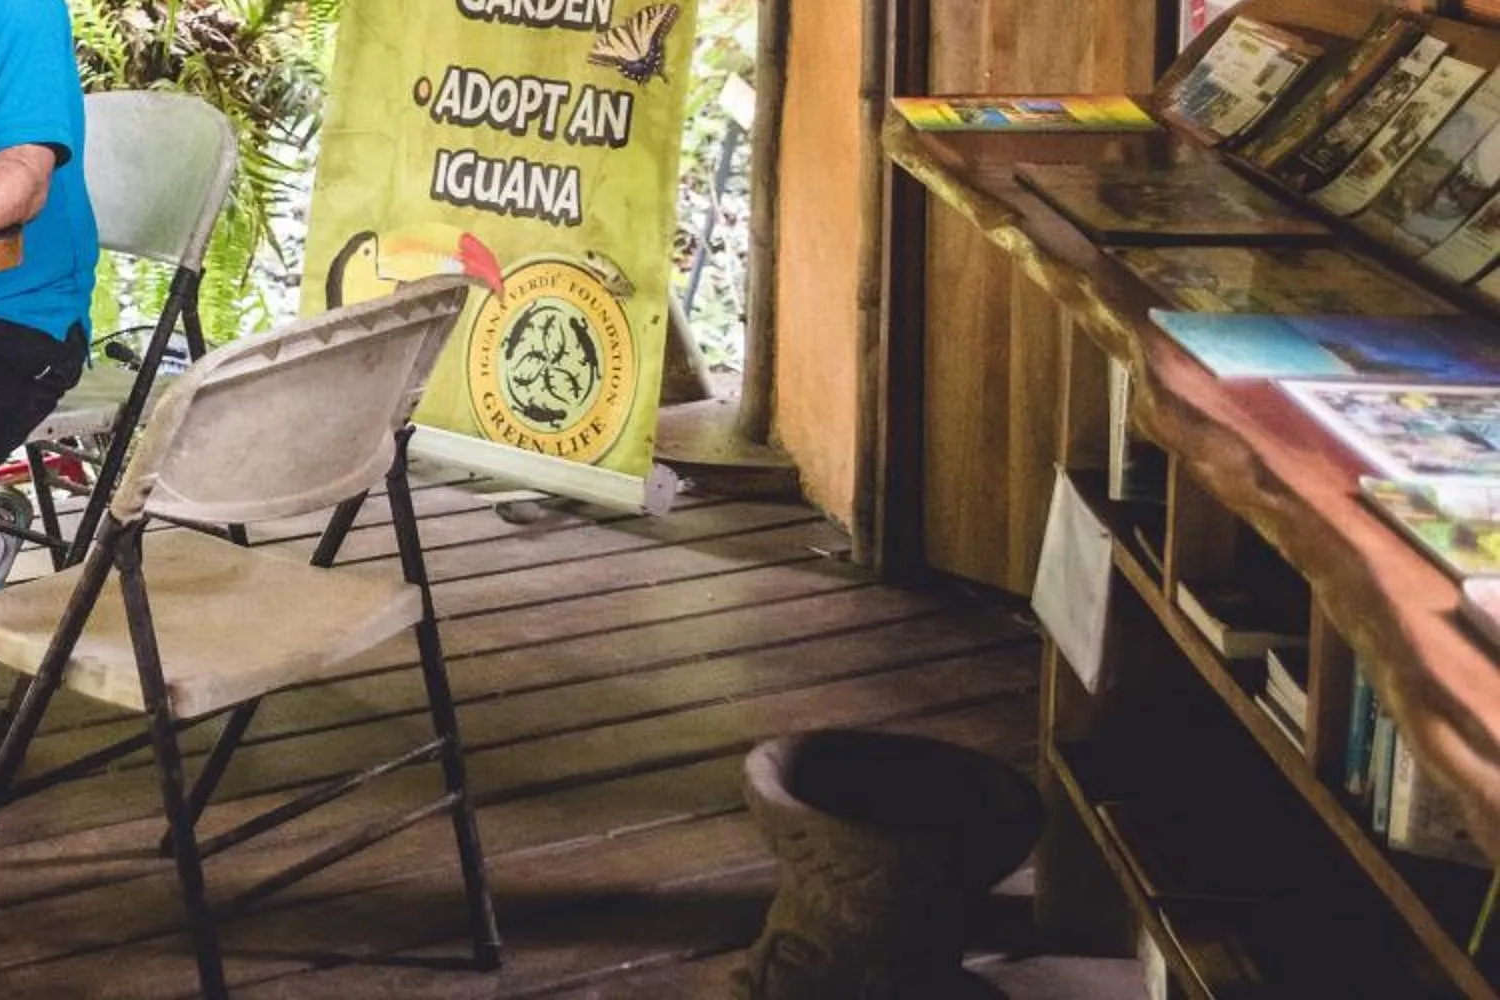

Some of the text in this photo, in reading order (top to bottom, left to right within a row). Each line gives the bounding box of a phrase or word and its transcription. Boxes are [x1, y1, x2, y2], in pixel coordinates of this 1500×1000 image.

[432, 66, 632, 147] ADOPT AN
[432, 149, 581, 226] IGUANA
[568, 280, 624, 407] FOUNDATION
[482, 391, 607, 458] GREEN LIFE
